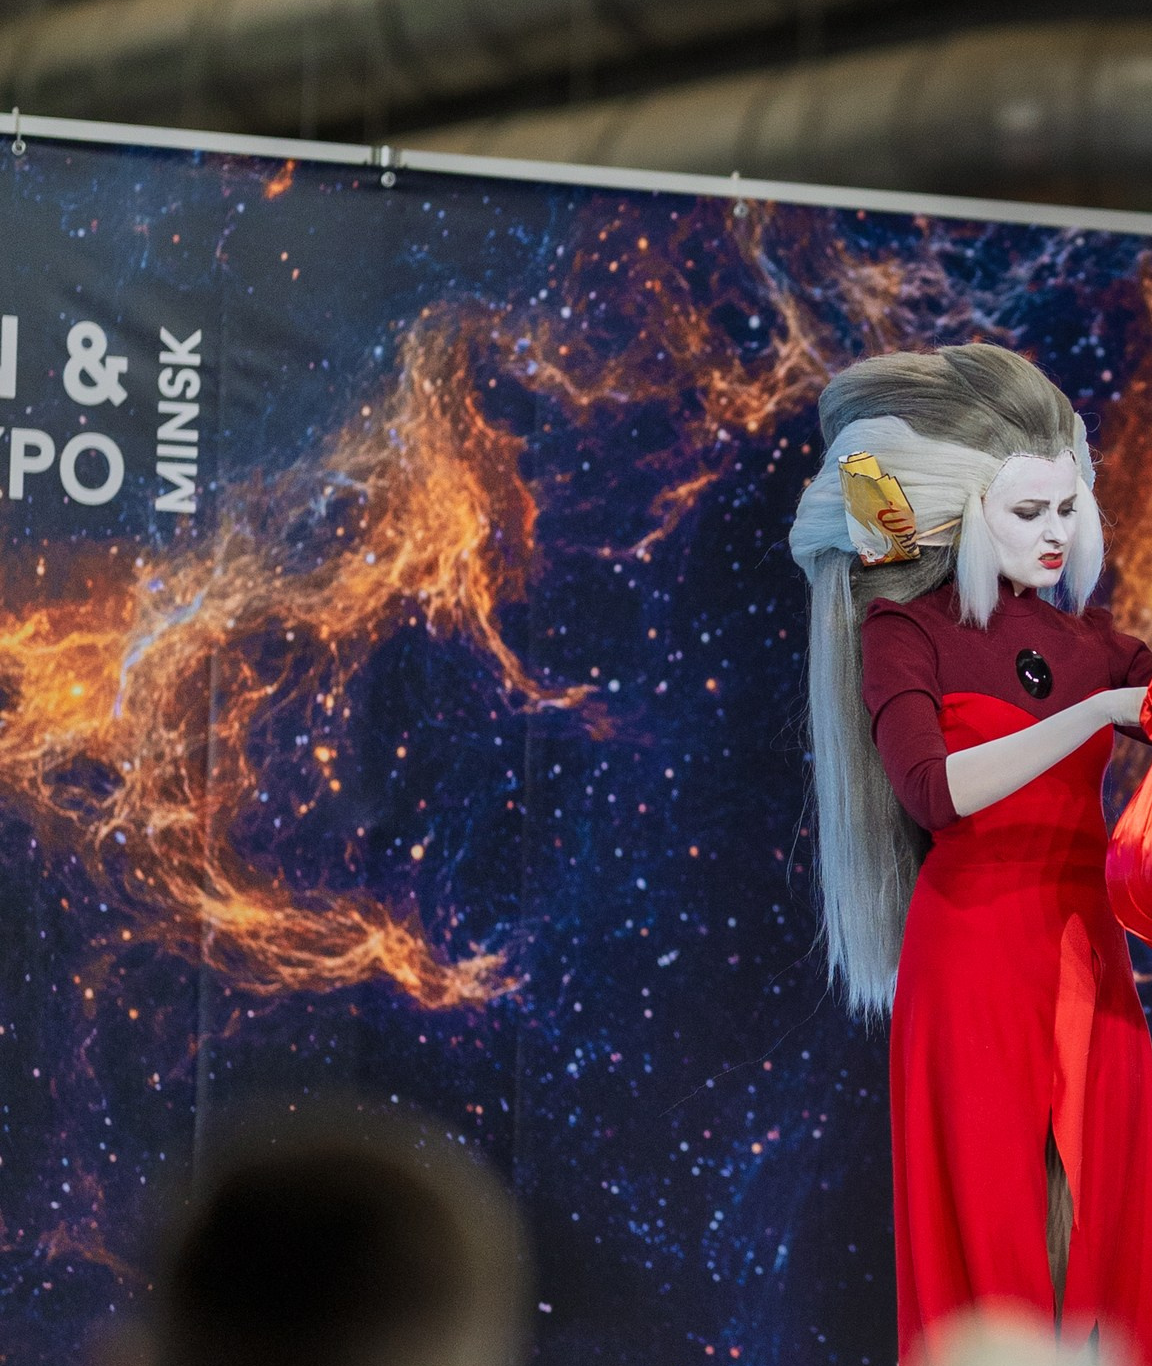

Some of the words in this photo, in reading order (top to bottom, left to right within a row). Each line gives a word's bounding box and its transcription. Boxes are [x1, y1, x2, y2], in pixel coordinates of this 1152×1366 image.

[63, 320, 128, 407] &
[155, 326, 202, 514] MINSK
[0, 427, 124, 505] PO
